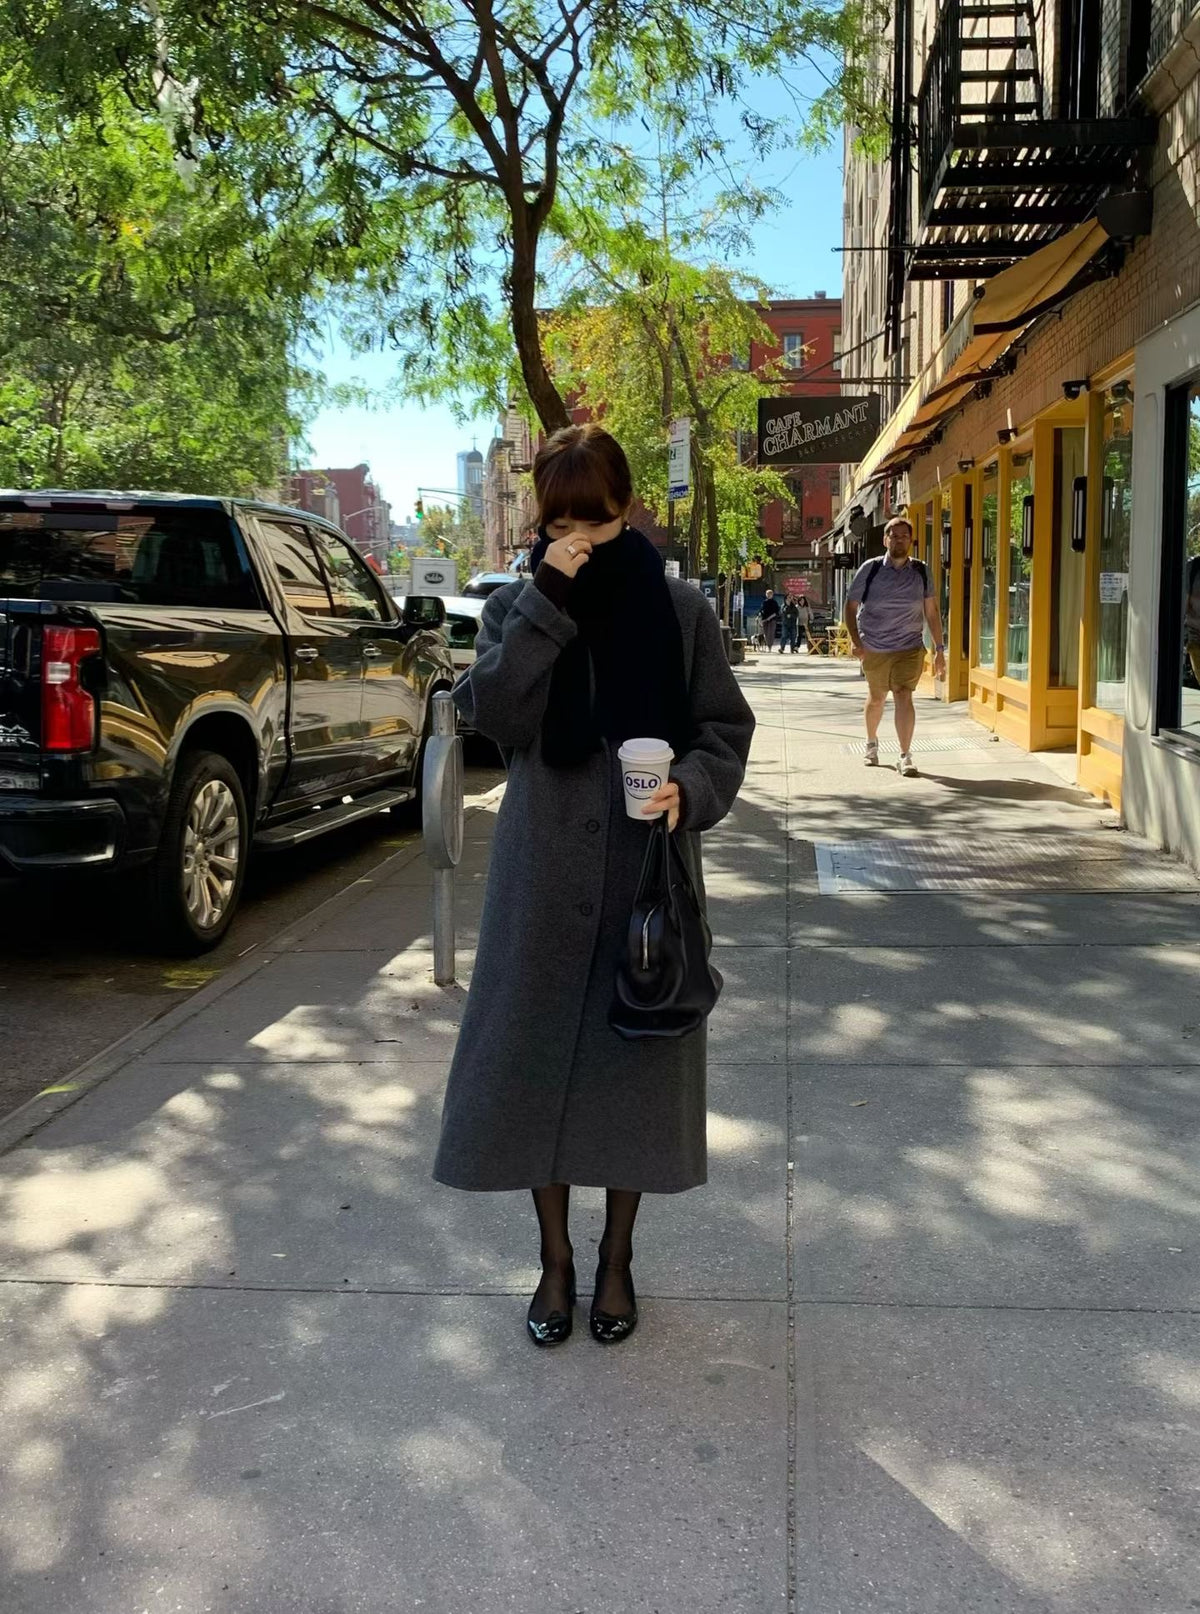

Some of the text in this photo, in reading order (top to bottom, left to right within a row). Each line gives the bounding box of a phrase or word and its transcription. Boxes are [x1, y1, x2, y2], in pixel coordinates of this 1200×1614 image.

[763, 402, 869, 456] CHARMANT
[766, 411, 803, 435] CAFE
[626, 776, 658, 789] OSLO
